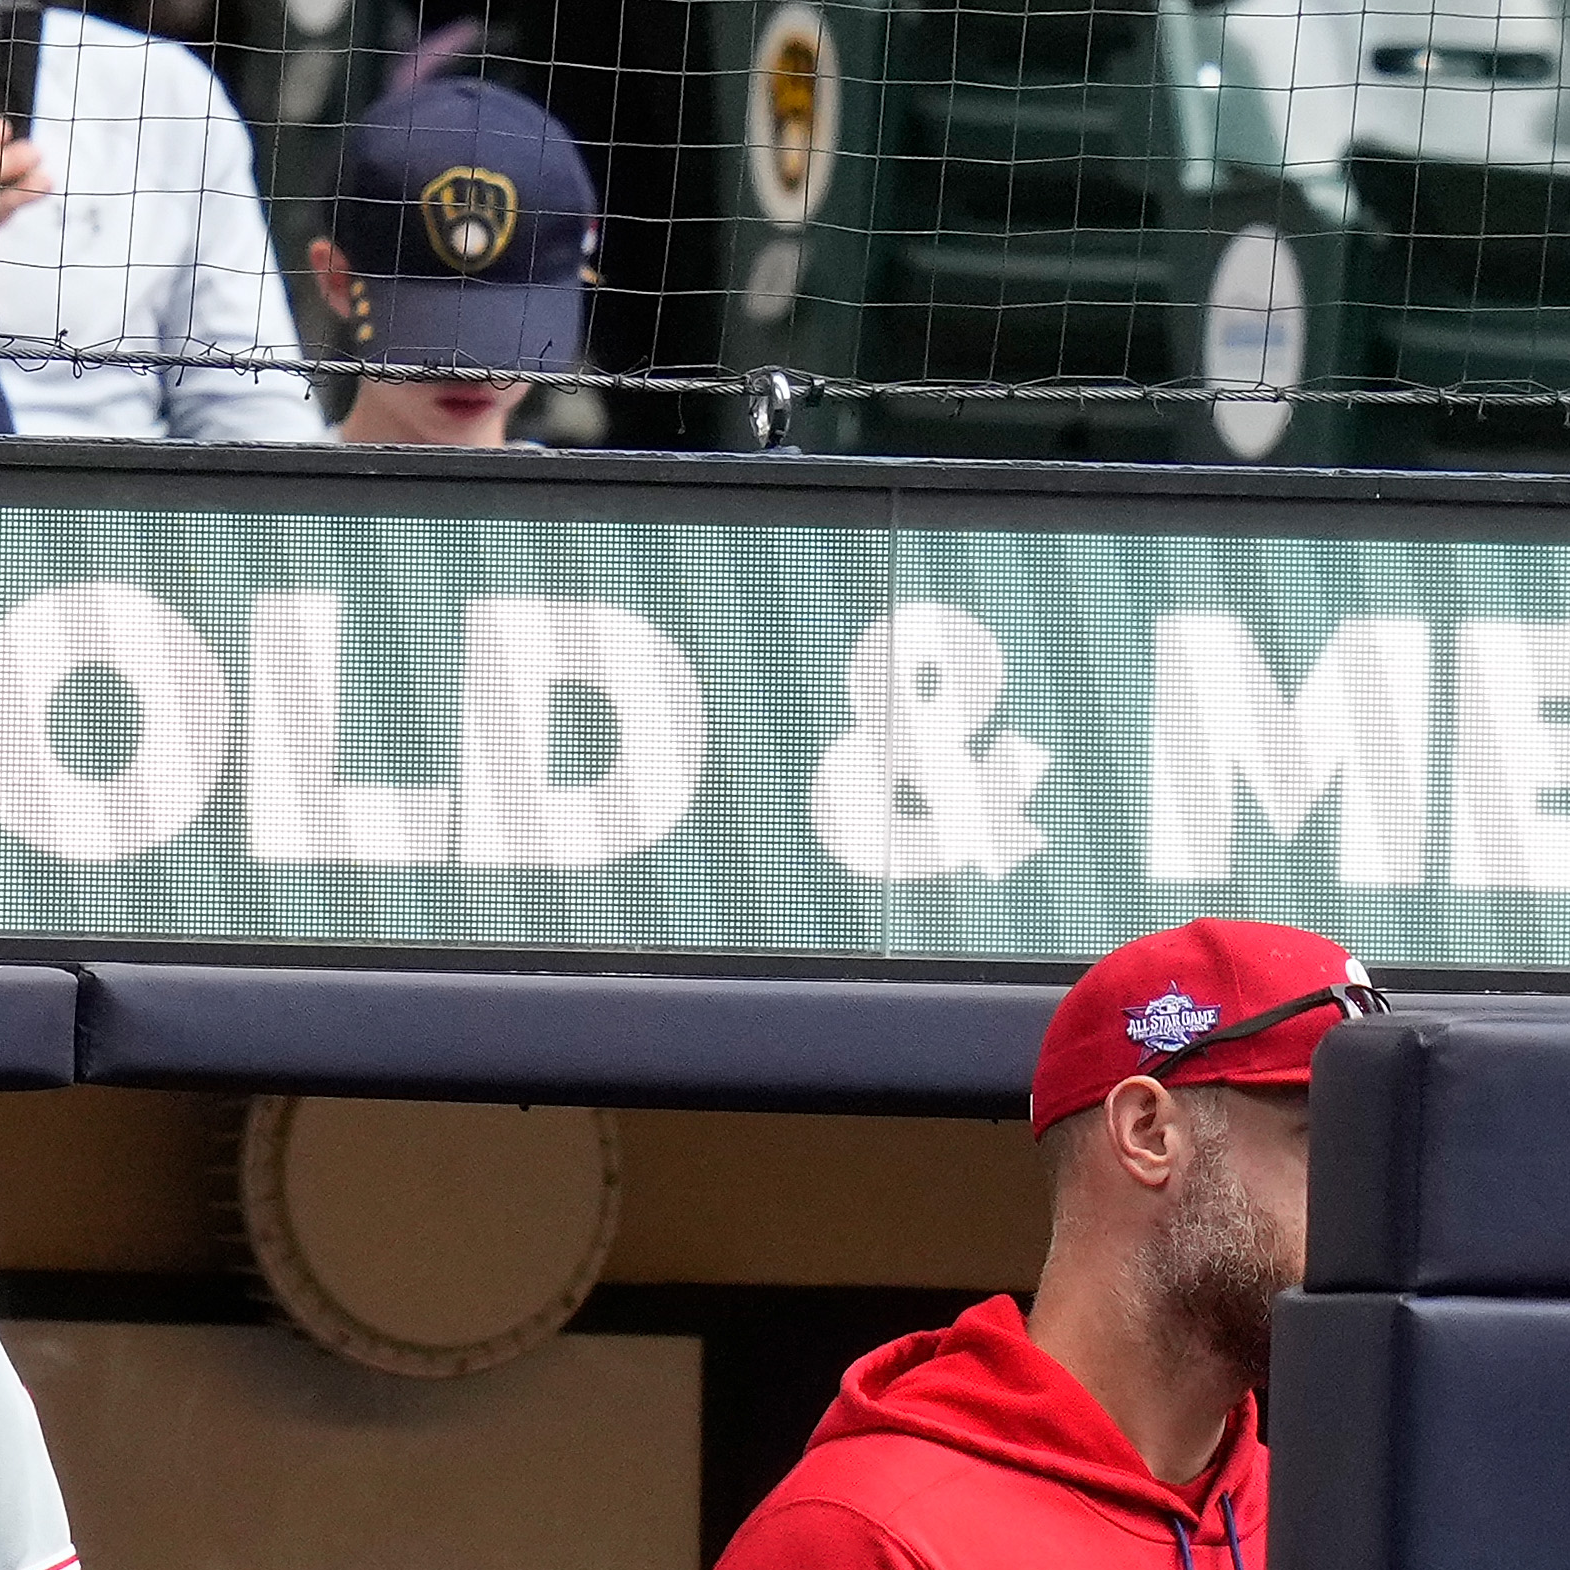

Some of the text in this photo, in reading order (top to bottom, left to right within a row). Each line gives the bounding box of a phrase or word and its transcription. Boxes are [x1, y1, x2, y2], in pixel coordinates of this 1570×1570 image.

[811, 599, 1051, 881] &
[1146, 608, 1570, 889] ME
[1149, 1014, 1182, 1031] STAR
[1181, 1009, 1216, 1026] GAME
